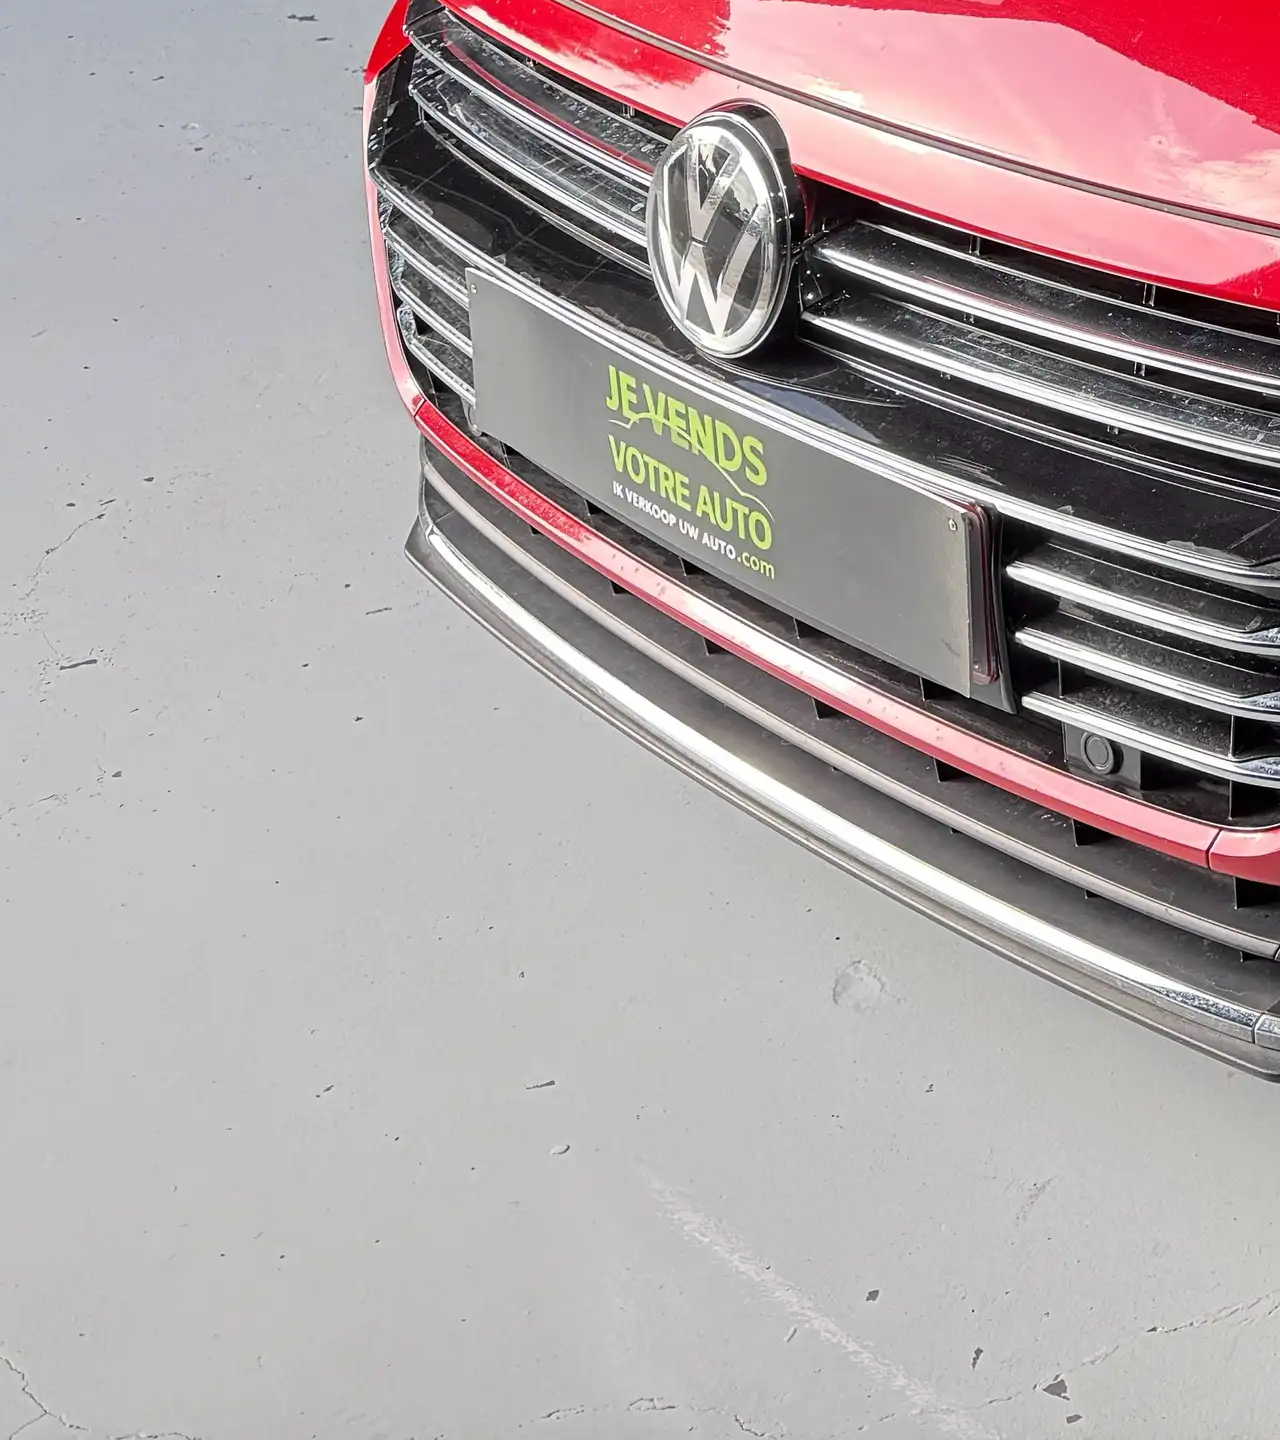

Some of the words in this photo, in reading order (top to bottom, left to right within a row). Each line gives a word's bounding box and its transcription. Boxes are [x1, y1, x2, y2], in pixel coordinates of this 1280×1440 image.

[605, 364, 638, 419] JE
[643, 382, 768, 487] VENDS
[608, 433, 692, 513] VOTRE
[695, 484, 774, 551] AUTO
[612, 480, 625, 499] IK
[626, 487, 677, 528] VERKOOP
[678, 518, 700, 542] UW
